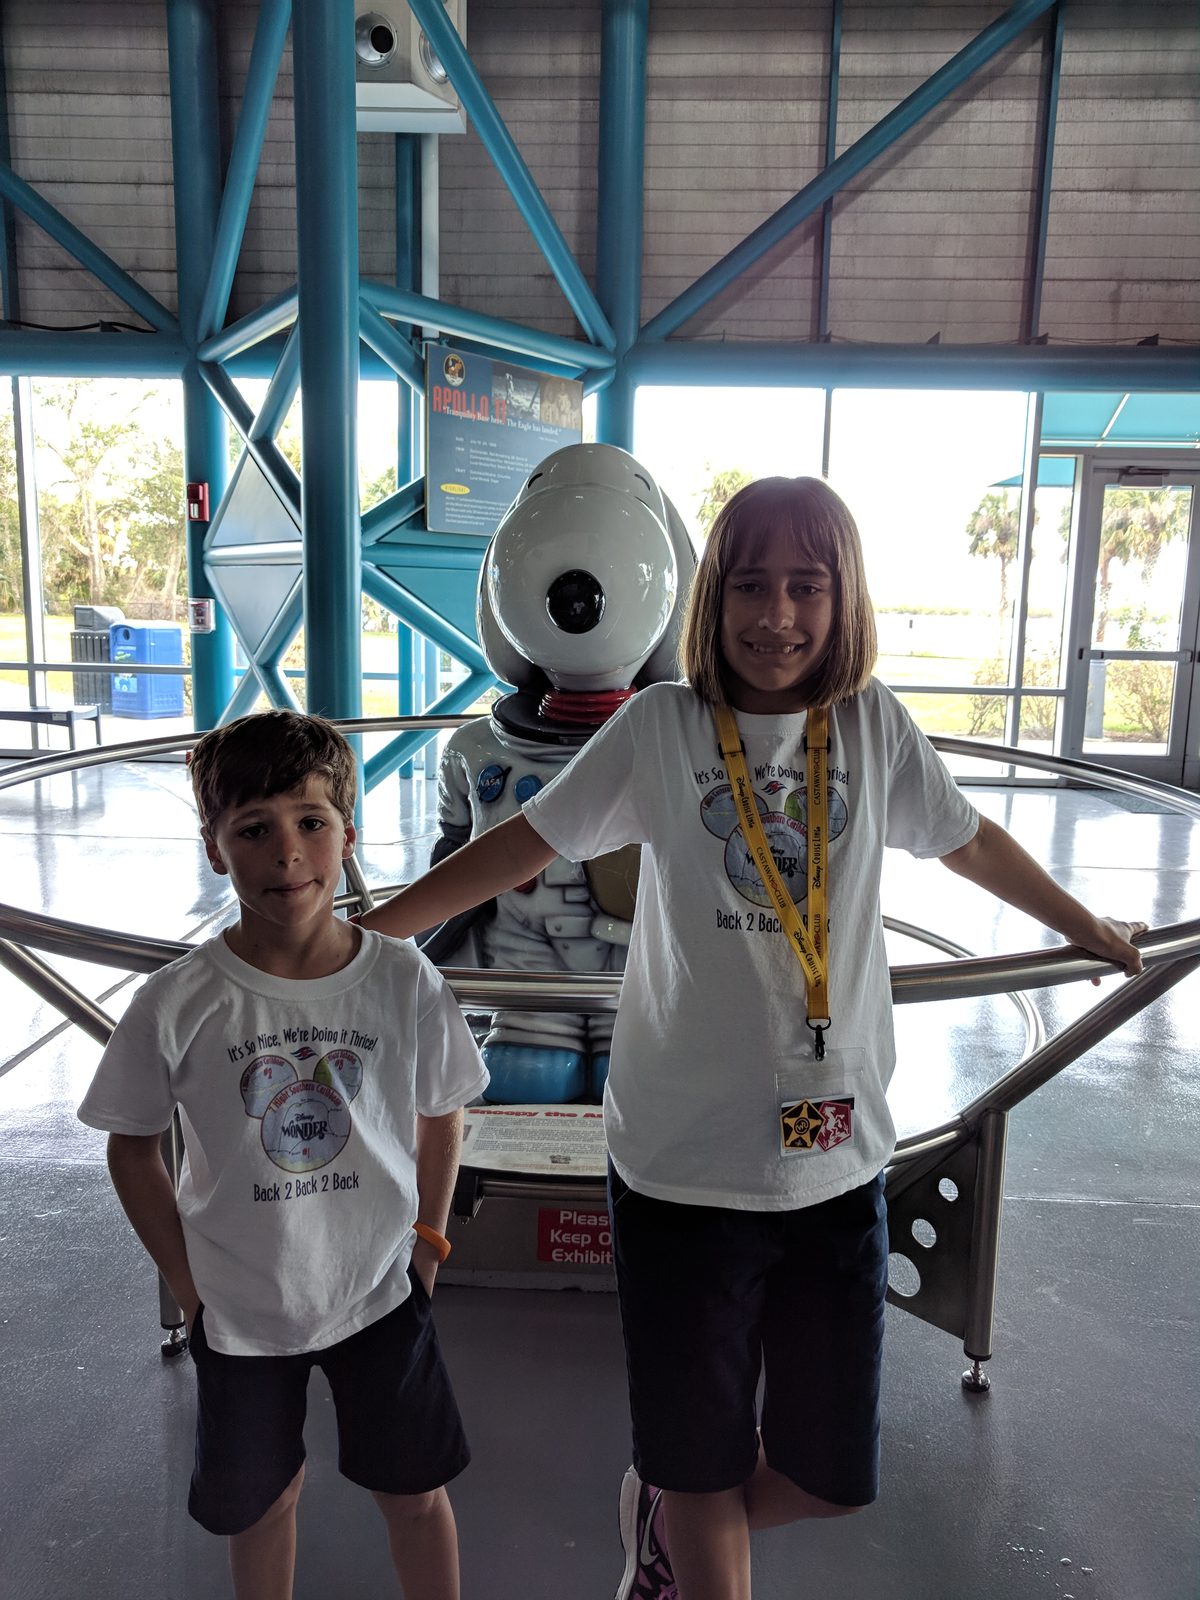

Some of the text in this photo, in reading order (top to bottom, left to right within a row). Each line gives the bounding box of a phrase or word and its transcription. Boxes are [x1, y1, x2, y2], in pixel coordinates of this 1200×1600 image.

[433, 385, 489, 421] APOLLO
[507, 419, 517, 427] The
[518, 421, 532, 432] Eagle
[481, 779, 500, 787] NASA
[694, 771, 709, 784] It's
[711, 767, 724, 781] So
[754, 763, 804, 783] We're Doing
[813, 771, 821, 805] CASTAWAY
[760, 814, 786, 825] outhern
[745, 849, 798, 878] WDER
[757, 847, 787, 909] CASTAWAY CLUB
[812, 866, 823, 890] Disney
[716, 909, 742, 931] Back
[747, 912, 755, 932] 2
[227, 1026, 379, 1063] It's So Nice, We're Doing it Thrice!
[273, 1091, 290, 1109] Night
[289, 1082, 315, 1095] Southern
[316, 1084, 342, 1106] Caribbean
[295, 1113, 314, 1121] Disney
[467, 1108, 539, 1117] Snoopy
[281, 1120, 328, 1141] WONDER
[302, 1147, 311, 1158] #1
[254, 1171, 360, 1202] Back 2 Back 2 Back
[560, 1210, 610, 1226] Pleas
[550, 1229, 592, 1247] Keep
[551, 1248, 613, 1265] Exhibit
